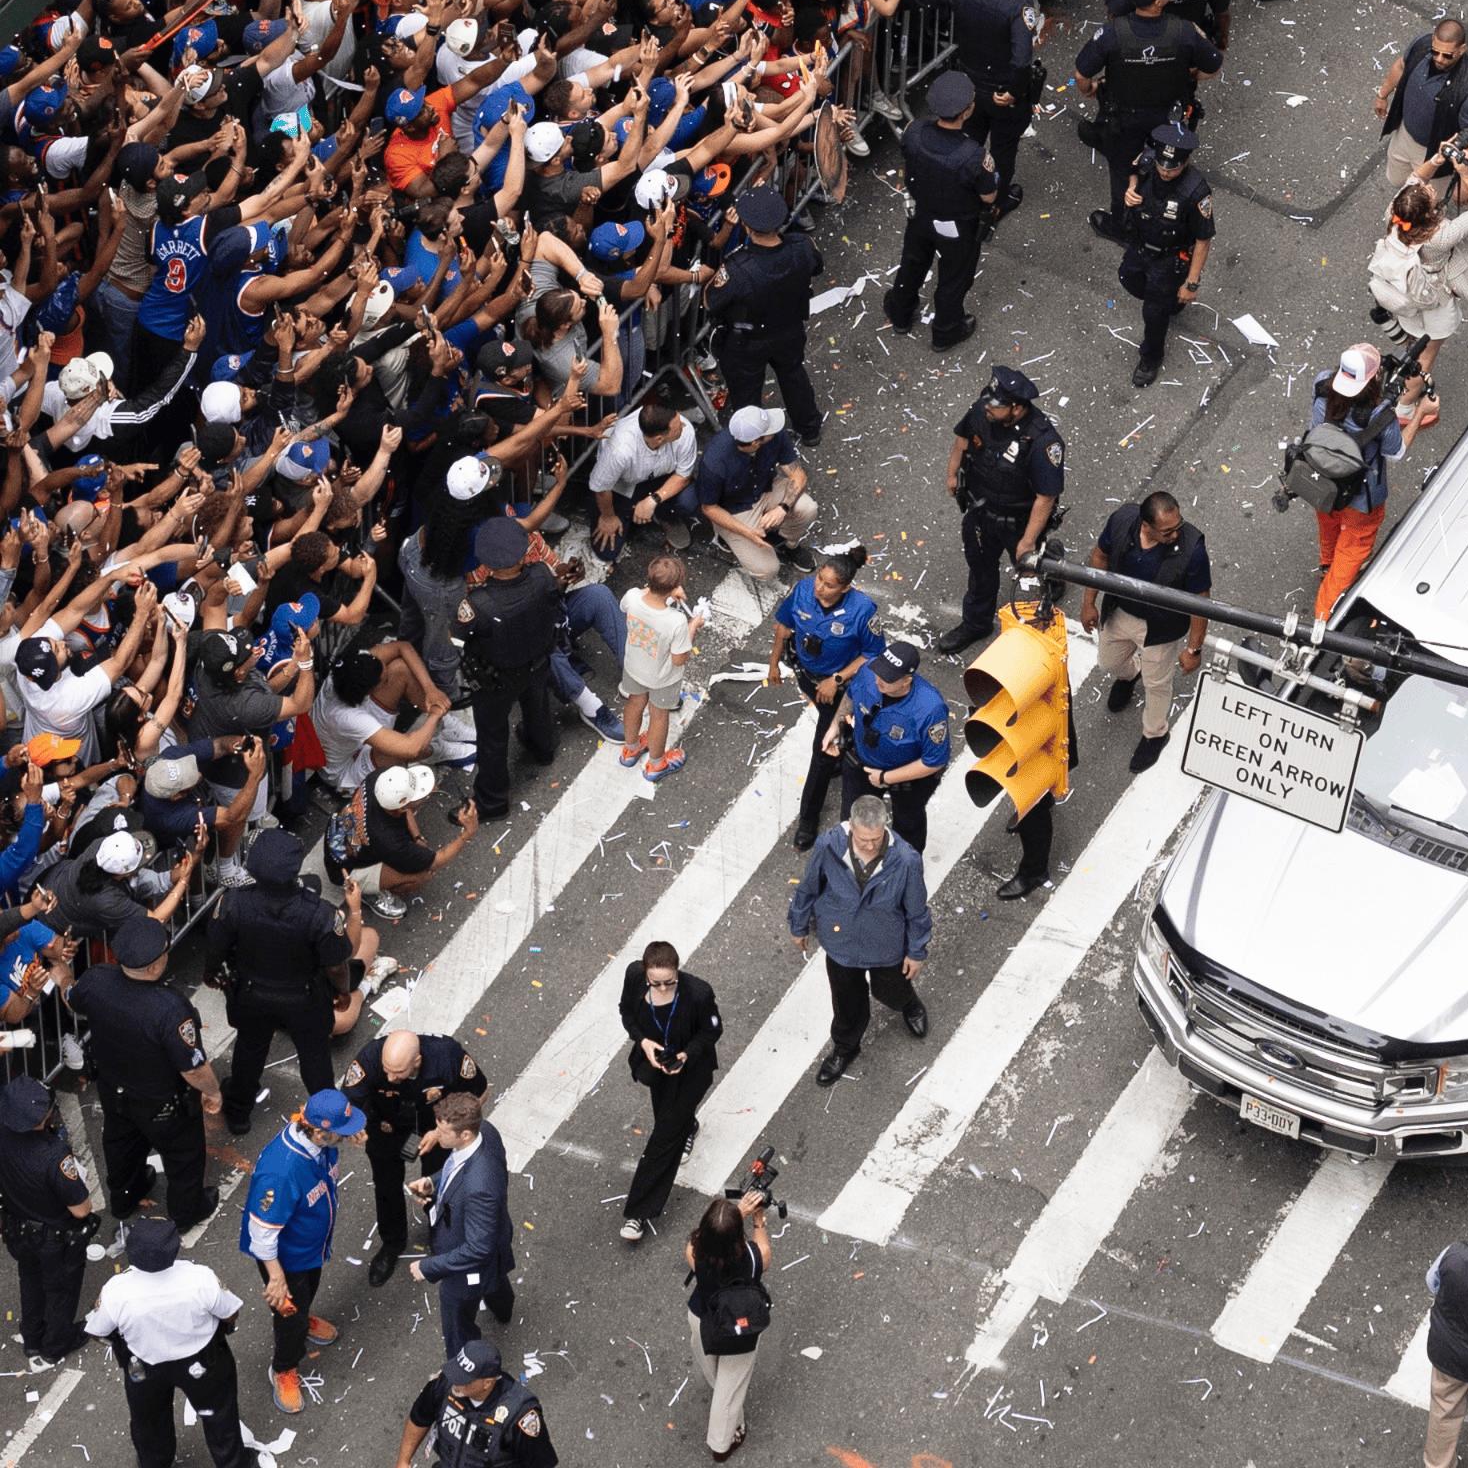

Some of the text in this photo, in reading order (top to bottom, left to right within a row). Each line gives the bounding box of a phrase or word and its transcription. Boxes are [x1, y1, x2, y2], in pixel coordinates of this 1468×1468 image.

[156, 239, 201, 261] BARRETT
[165, 257, 187, 293] 9
[1221, 695, 1335, 752] LEFT TURN
[1259, 733, 1288, 755] ON
[1194, 729, 1345, 799] GREEN ARROW
[1236, 767, 1294, 799] ONLY
[442, 1405, 478, 1445] POLI
